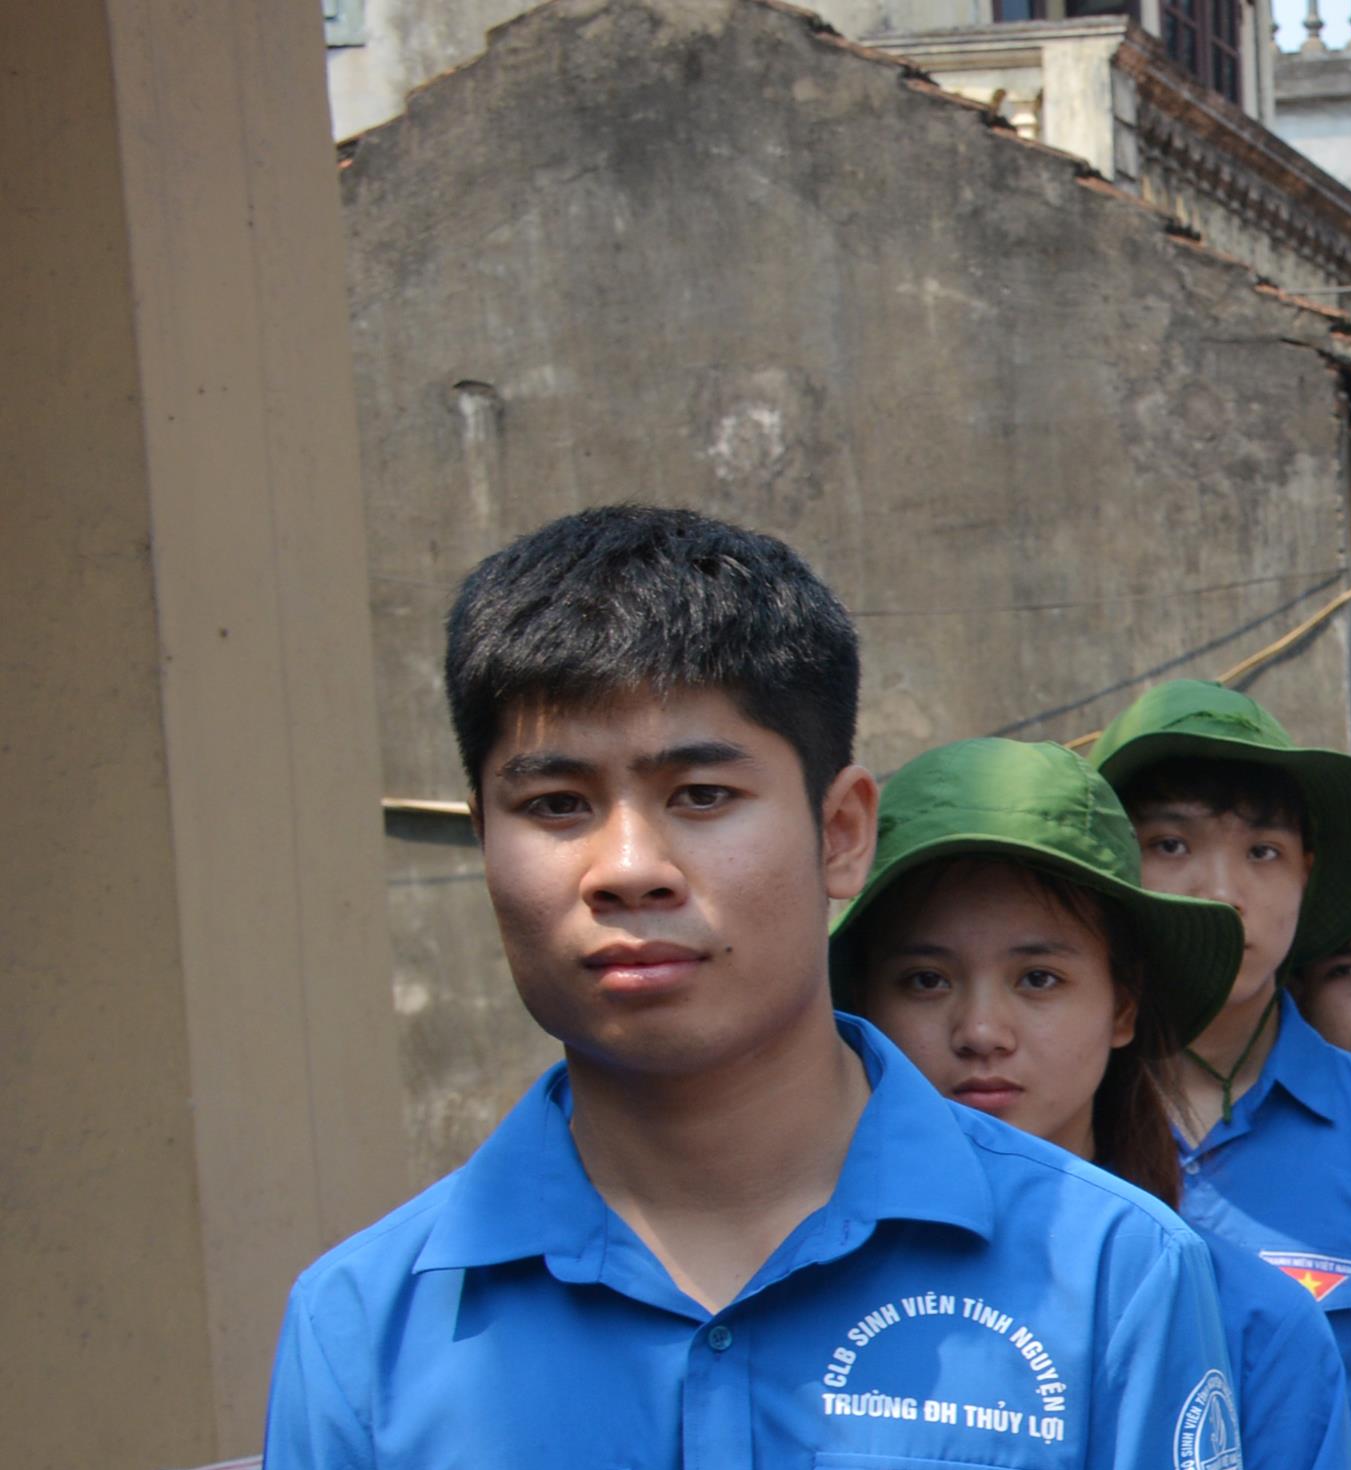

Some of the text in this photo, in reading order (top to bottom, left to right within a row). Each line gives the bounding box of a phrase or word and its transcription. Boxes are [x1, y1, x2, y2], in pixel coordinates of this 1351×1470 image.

[823, 1291, 1067, 1412] CLB SINH VIÊN TÌNH NGUYỆN
[822, 1389, 1065, 1445] TRƯỜNG ĐH THỦY LỢI
